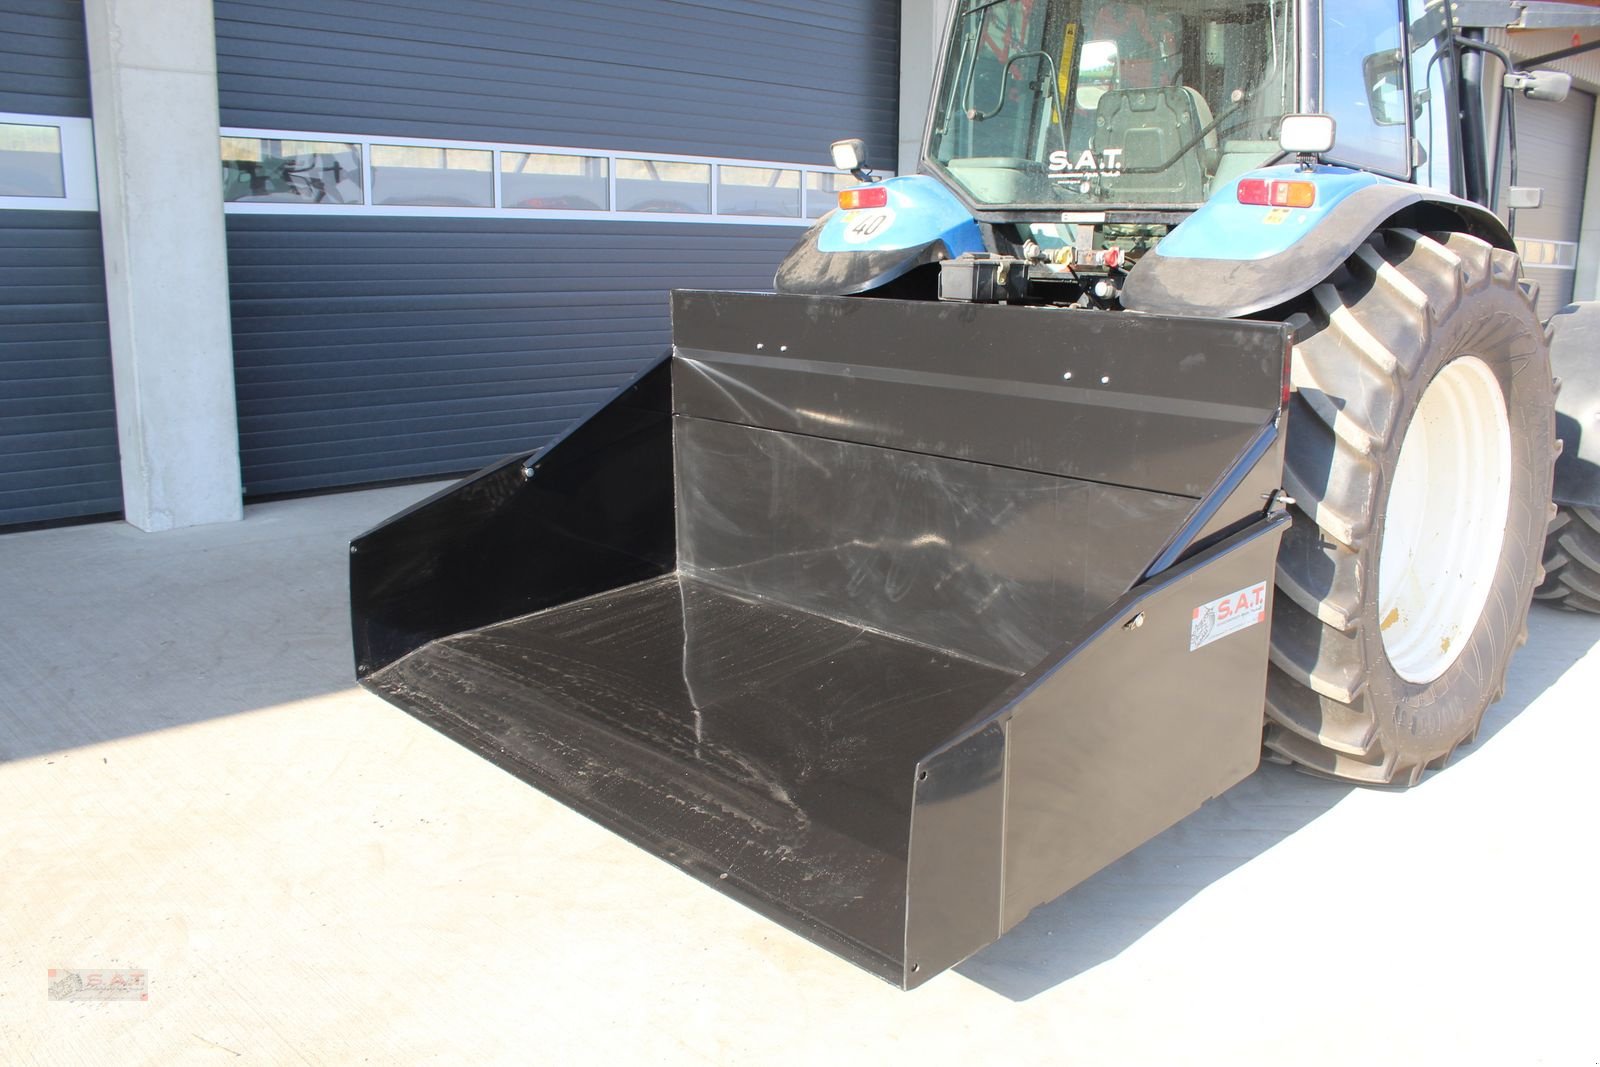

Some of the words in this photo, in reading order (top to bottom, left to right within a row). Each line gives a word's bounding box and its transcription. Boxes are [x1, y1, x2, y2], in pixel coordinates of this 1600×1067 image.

[1048, 148, 1123, 171] S.A.T.
[851, 214, 887, 236] 40
[1216, 585, 1265, 620] S.A.T.
